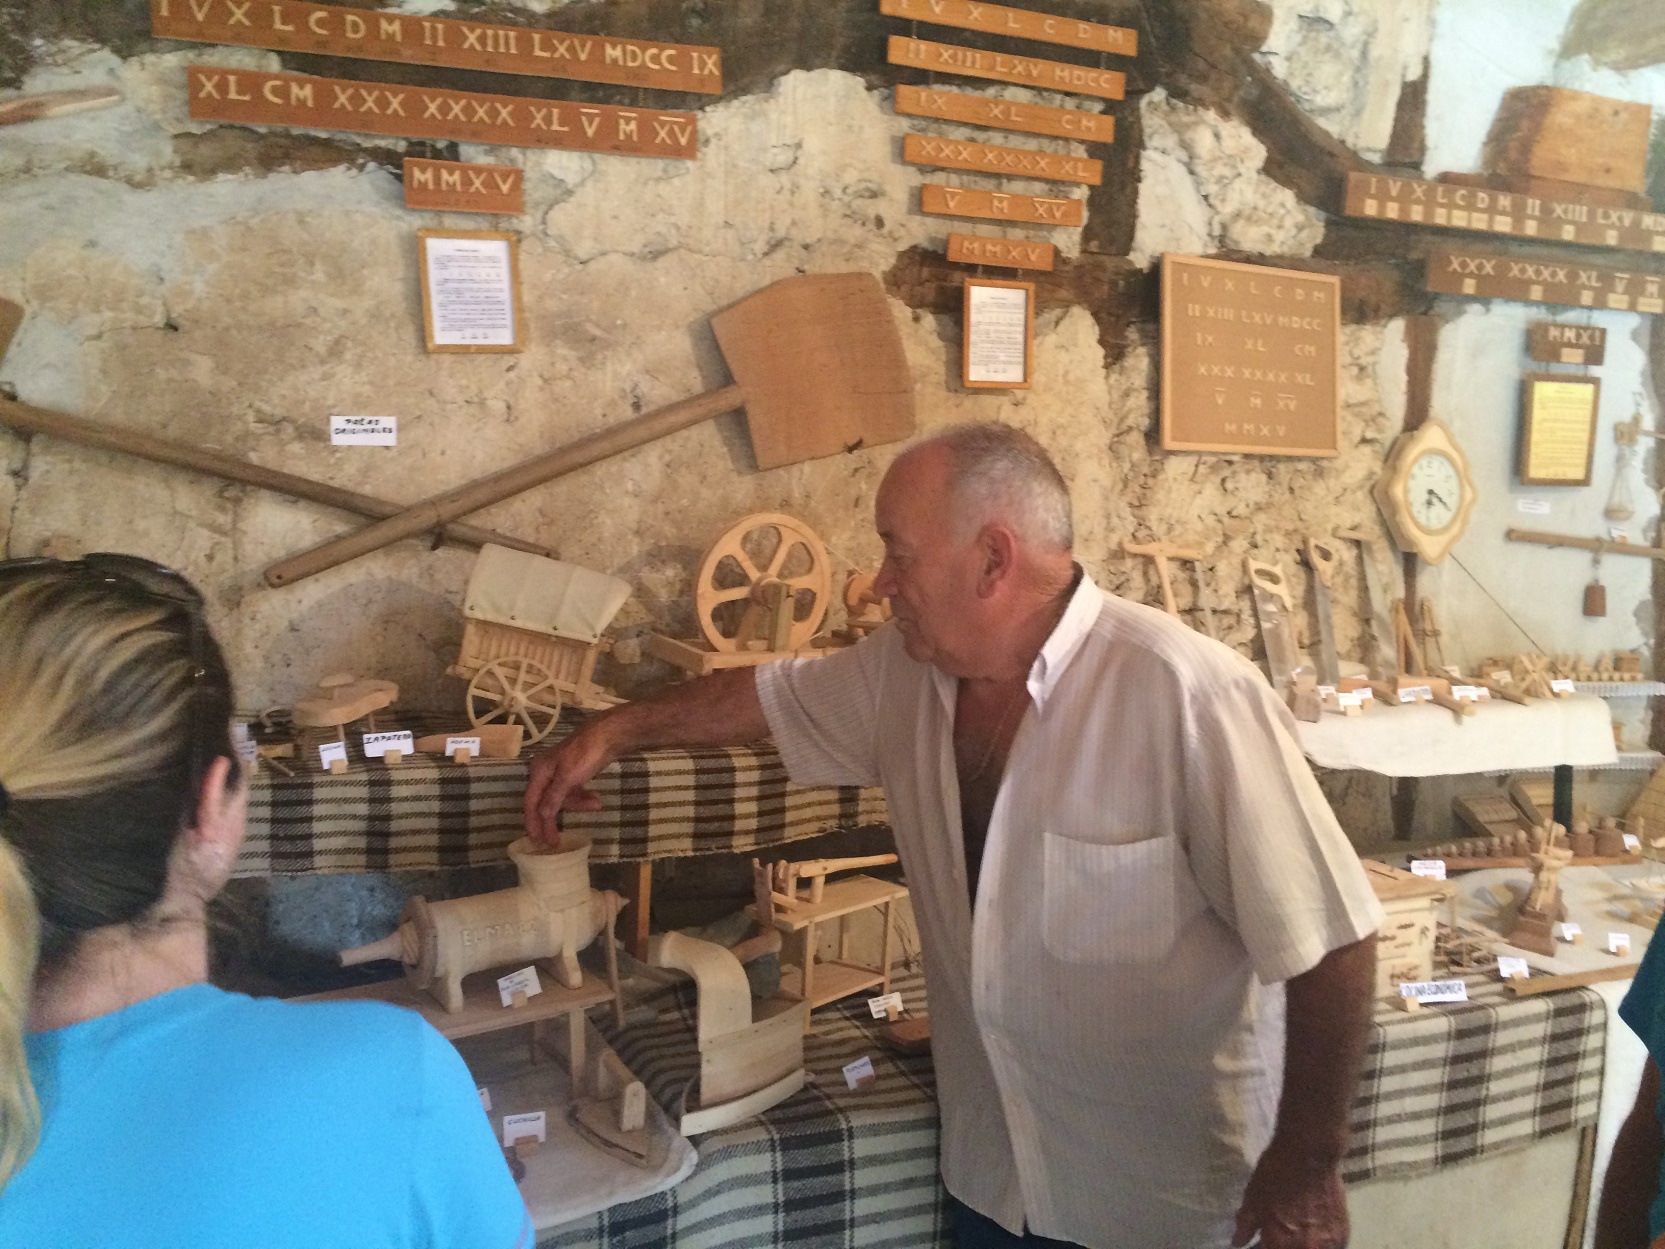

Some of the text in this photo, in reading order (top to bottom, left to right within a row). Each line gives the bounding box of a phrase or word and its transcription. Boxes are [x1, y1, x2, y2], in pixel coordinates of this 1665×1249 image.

[188, 0, 212, 21] V
[226, 0, 252, 26] X
[272, 6, 294, 31] L
[309, 11, 329, 35] C
[345, 15, 365, 39] D
[380, 18, 401, 42] M
[422, 22, 445, 47] II
[460, 25, 518, 54] XIII
[531, 33, 592, 61] LXV
[605, 43, 678, 70] MDCC
[691, 52, 720, 76] IX
[968, 5, 983, 22] X
[1007, 13, 1021, 28] L
[1043, 20, 1055, 34] C
[1078, 24, 1091, 39] D
[1107, 28, 1124, 45] M
[907, 42, 1111, 89] II XIII LXV MDCC
[198, 74, 251, 101] XL
[263, 80, 313, 108] CM
[332, 85, 406, 117] XXX
[422, 95, 515, 127] XXXX
[529, 106, 570, 132] XL
[918, 92, 948, 111] IX
[988, 103, 1023, 122] XL
[920, 140, 1091, 177] XXX XXXX XL
[412, 166, 515, 195] MMXV
[1388, 179, 1403, 198] V
[1411, 182, 1428, 201] X
[1436, 186, 1448, 203] L
[1455, 189, 1468, 206] C
[1551, 202, 1589, 222] XIII
[1596, 208, 1635, 227] LXV
[962, 239, 1041, 262] MMXV
[1448, 255, 1497, 276] XXX
[1508, 262, 1568, 283] XXXX
[1576, 270, 1602, 287] XL
[1241, 310, 1273, 326] LXV
[1278, 315, 1322, 331] MDCC
[1198, 363, 1235, 379] XXX
[1242, 366, 1288, 384] XXXX
